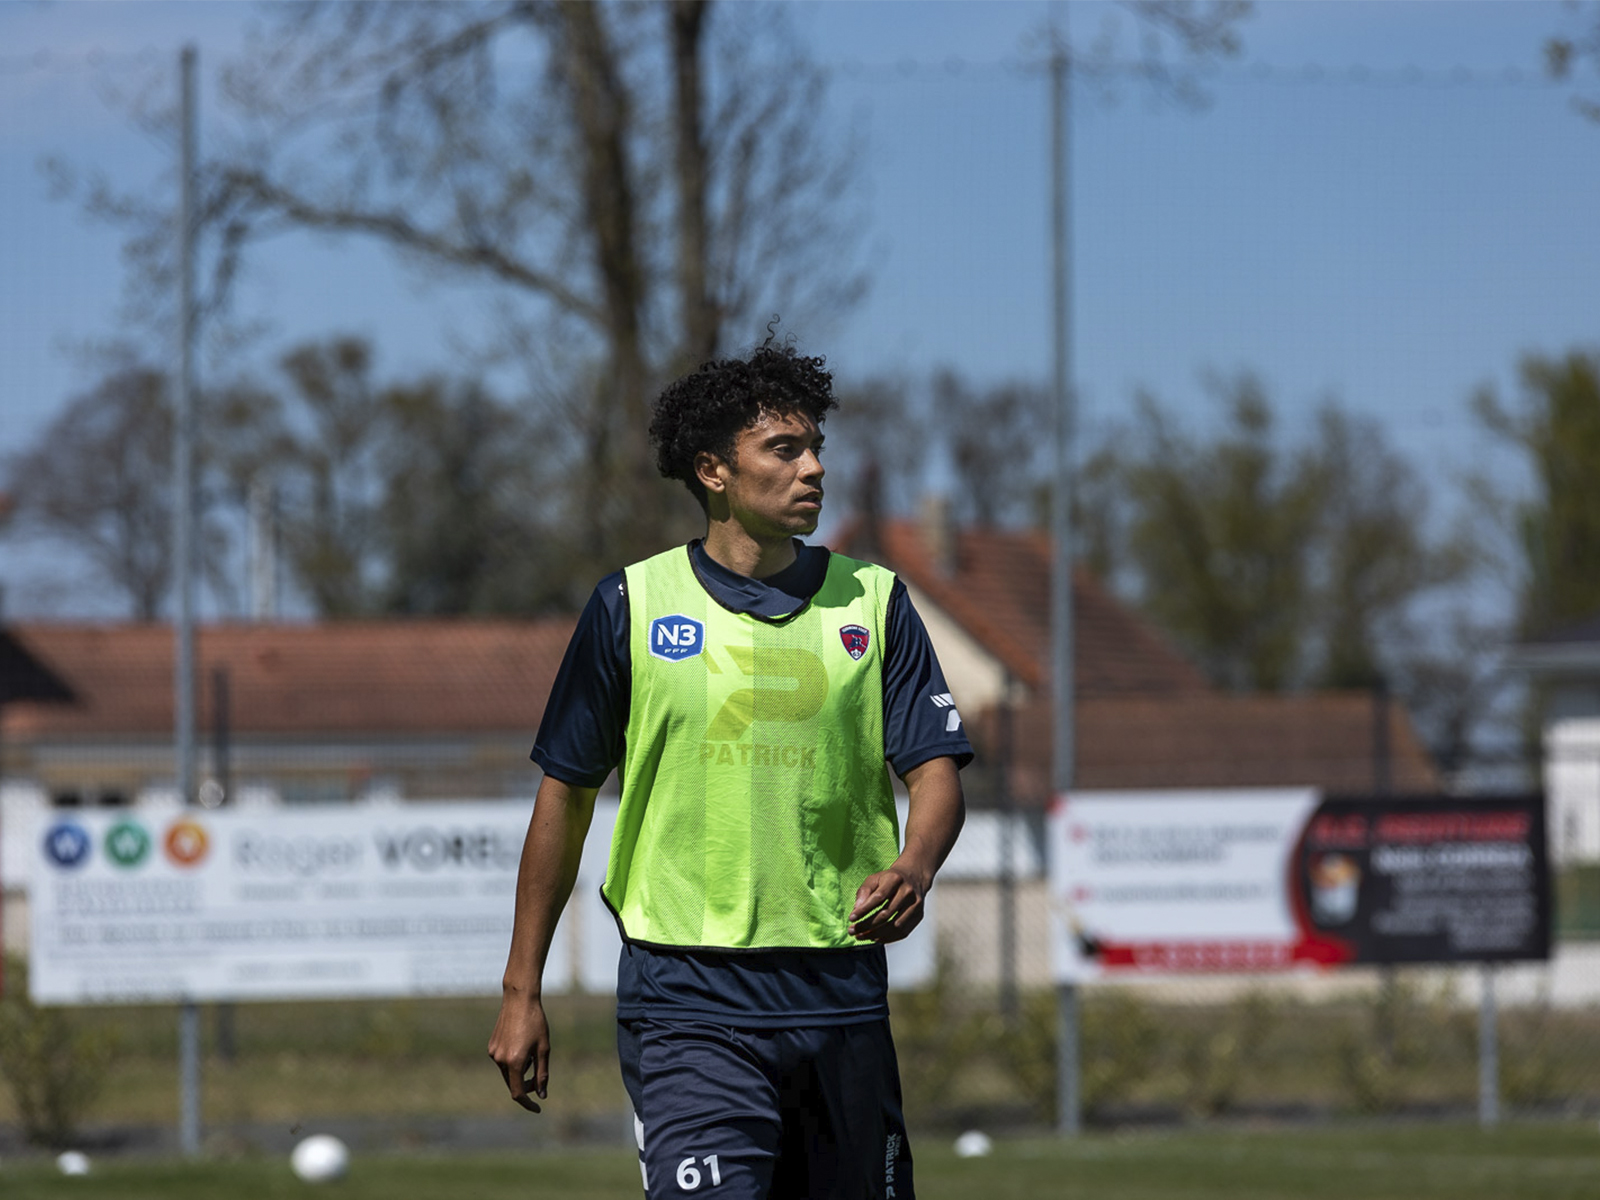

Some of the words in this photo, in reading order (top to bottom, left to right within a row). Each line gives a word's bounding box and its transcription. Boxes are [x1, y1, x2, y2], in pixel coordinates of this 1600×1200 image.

[657, 623, 697, 646] N3
[699, 742, 818, 770] PATRICK
[676, 1154, 721, 1190] 61
[885, 1133, 897, 1183] PATRICK
